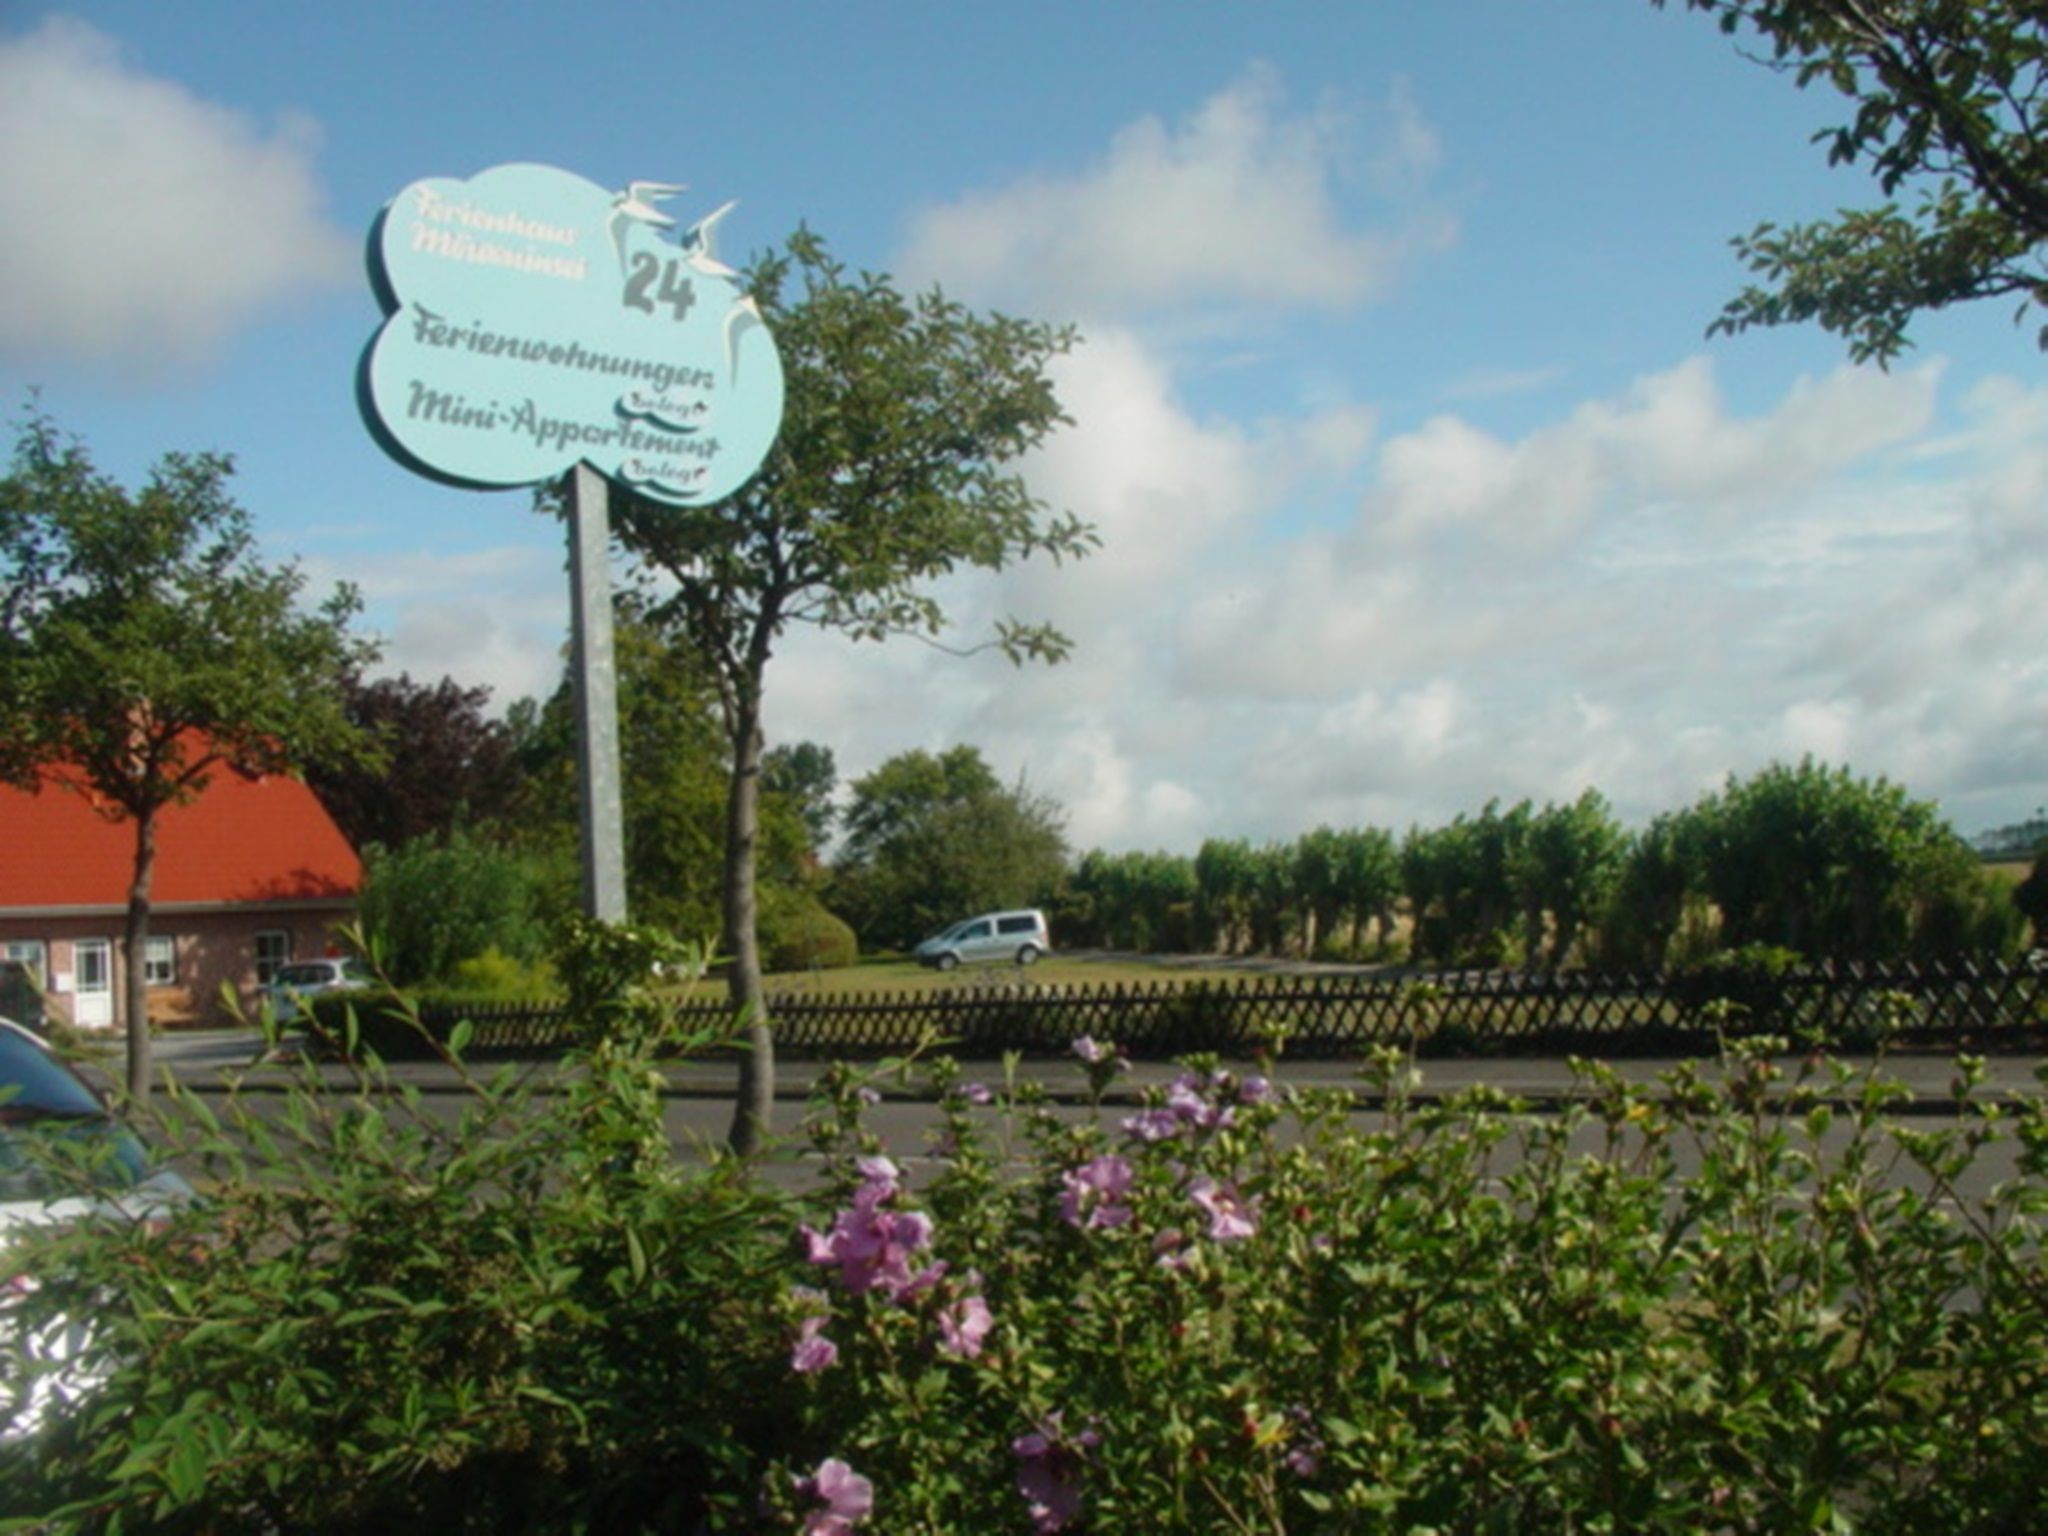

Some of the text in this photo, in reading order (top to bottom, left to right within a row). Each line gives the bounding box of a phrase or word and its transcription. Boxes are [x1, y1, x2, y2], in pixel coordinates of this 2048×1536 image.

[622, 251, 696, 322] 24
[411, 301, 715, 392] Ferienwohnungen
[406, 379, 722, 460] Mini-Appartement
